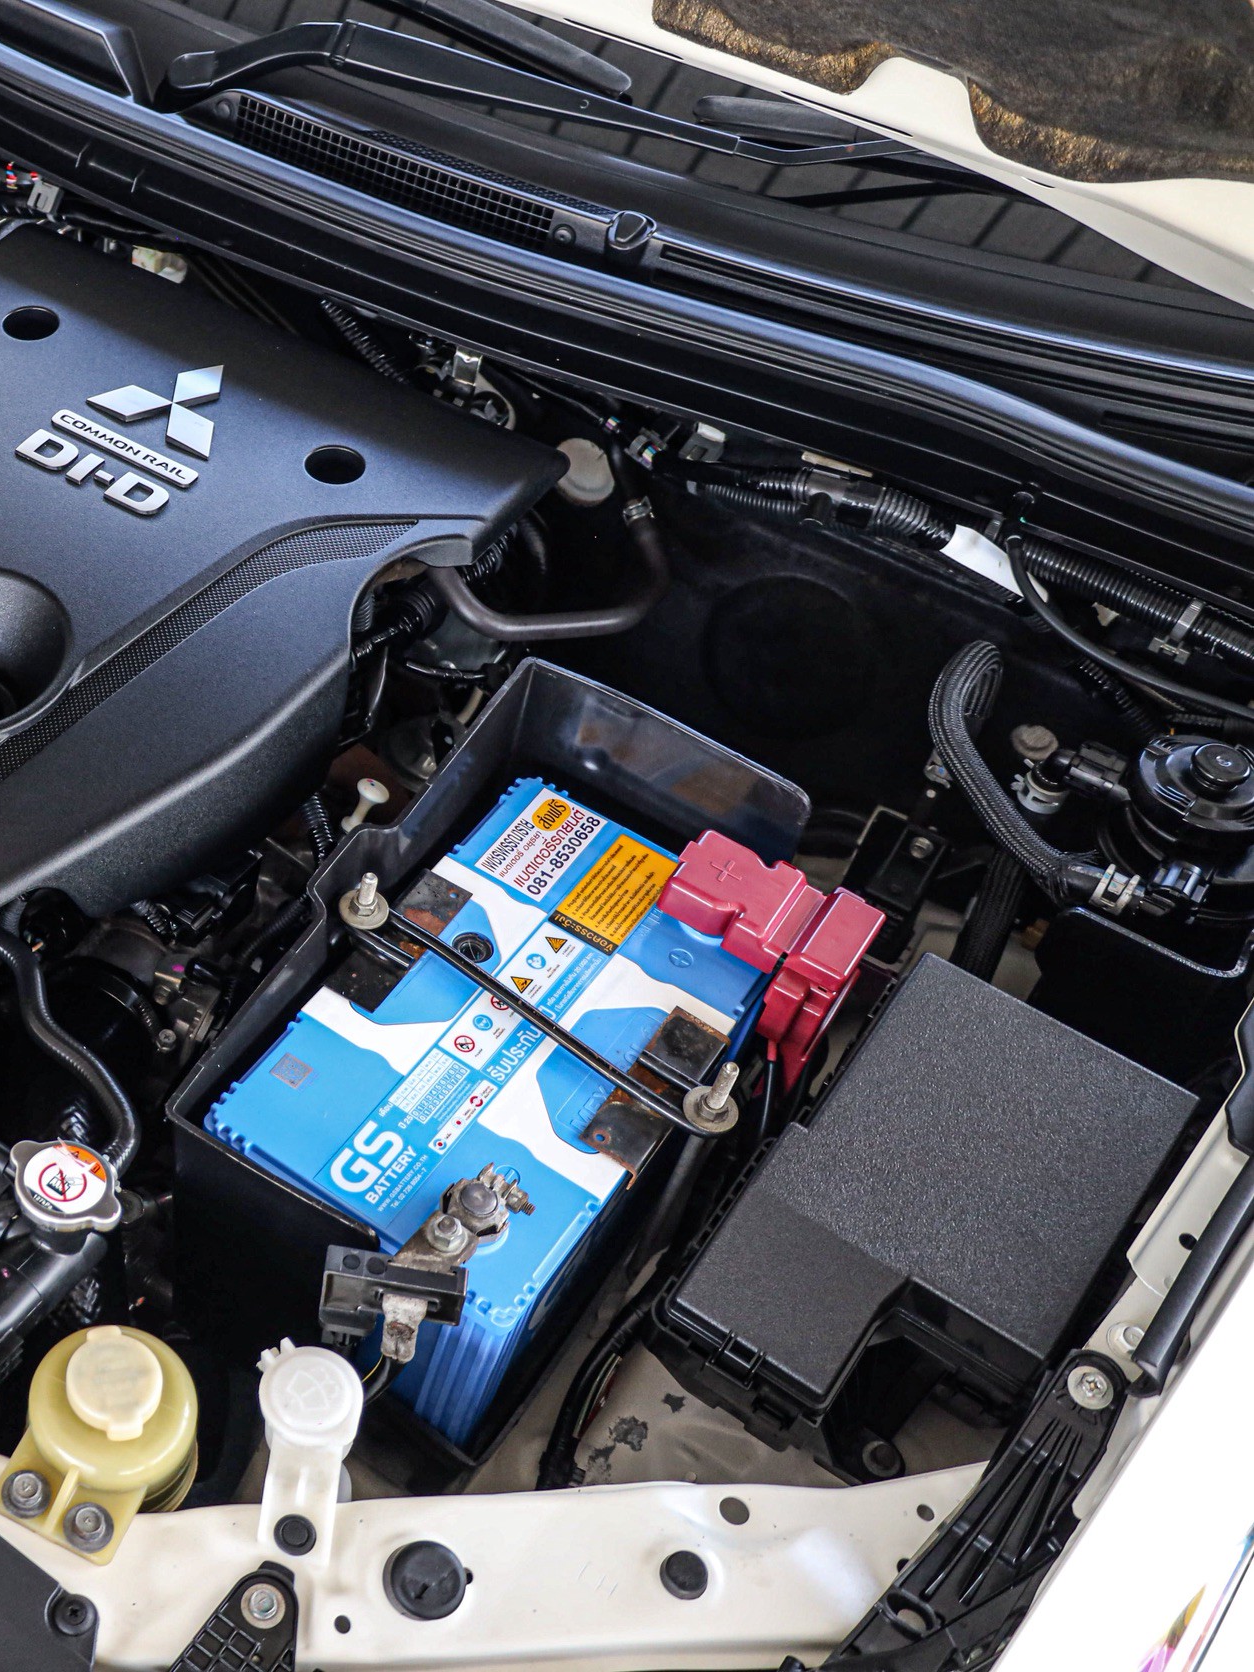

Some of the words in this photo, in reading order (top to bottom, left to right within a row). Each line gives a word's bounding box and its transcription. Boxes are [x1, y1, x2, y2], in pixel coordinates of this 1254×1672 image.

[14, 428, 170, 516] DI-D
[59, 414, 142, 457] COMMON
[142, 454, 187, 480] RAIL
[514, 807, 586, 888] แบตเตอรี่รถยนต์
[537, 798, 567, 829] ส่งฟรี
[527, 816, 601, 895] 081-8530658
[549, 914, 613, 952] ข้อควรระวัง!
[330, 1120, 403, 1192] GS
[363, 1144, 419, 1205] BATTERY
